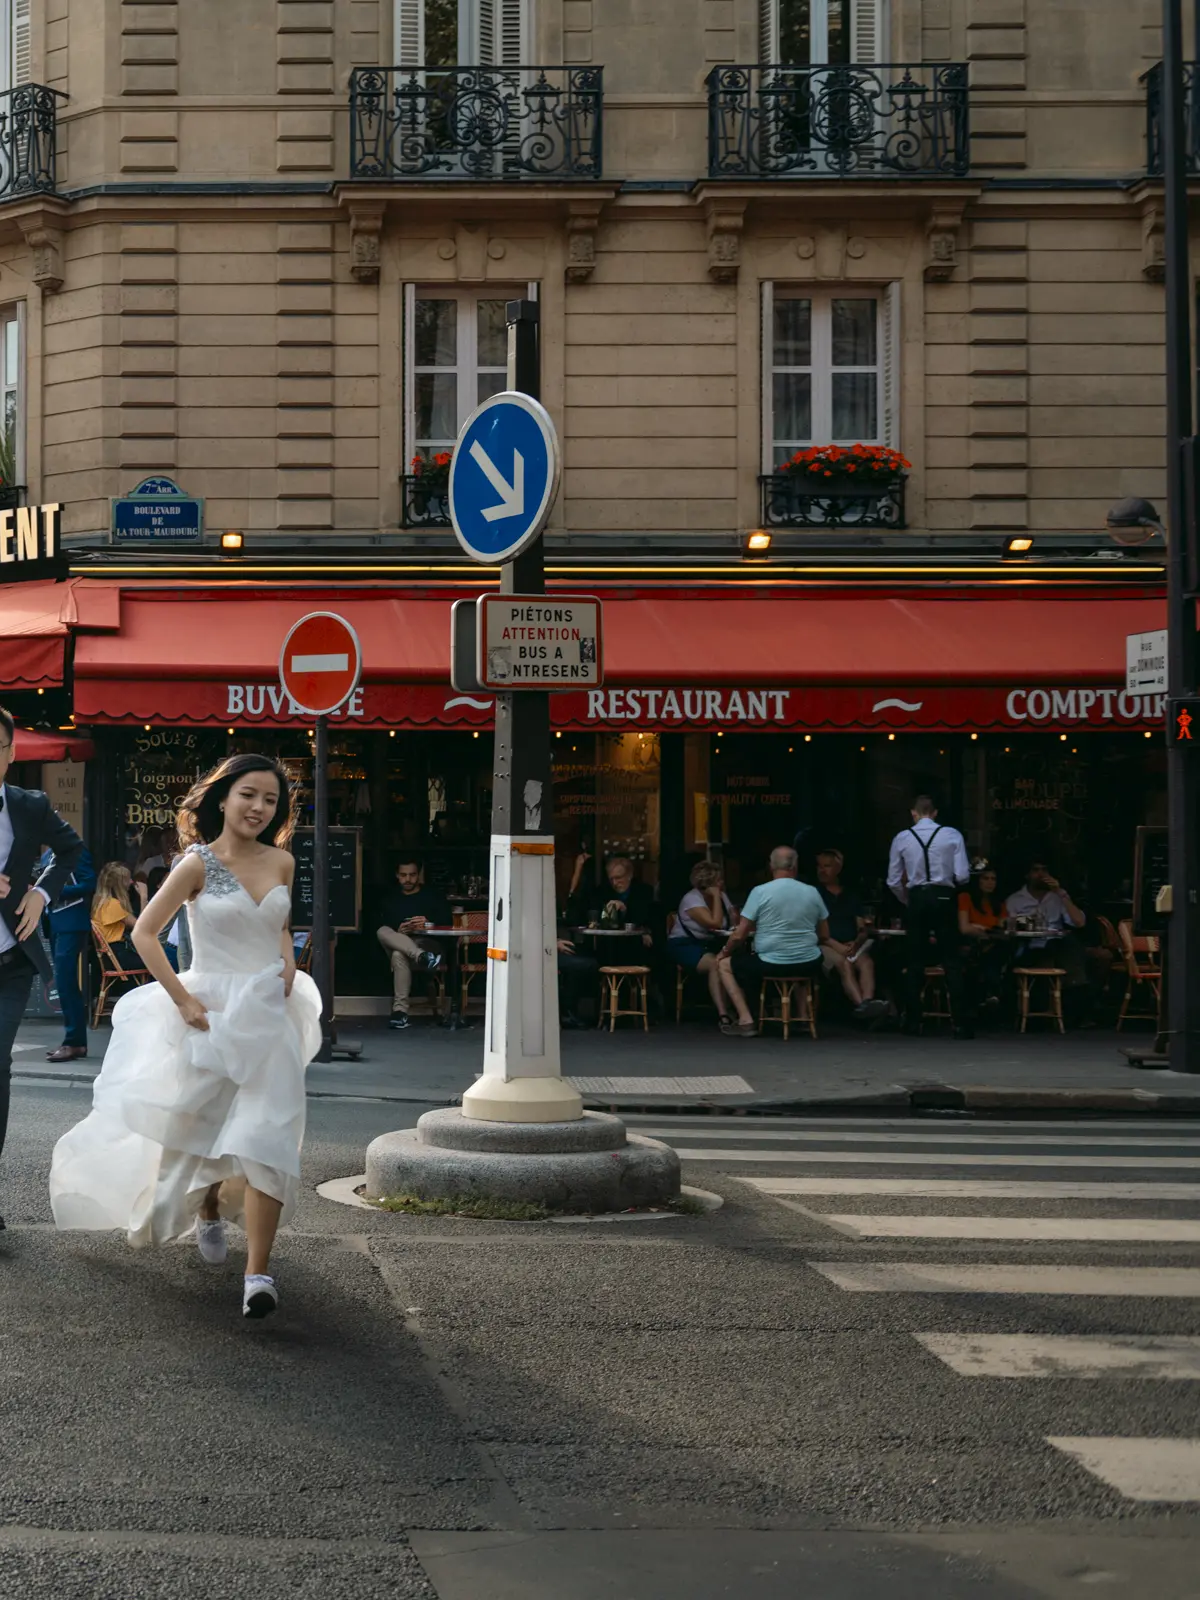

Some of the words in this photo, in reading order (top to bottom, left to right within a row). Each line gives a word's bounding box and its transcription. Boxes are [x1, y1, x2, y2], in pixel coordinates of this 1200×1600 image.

[134, 506, 180, 515] BOULEVARD
[151, 517, 164, 525] DE
[116, 528, 127, 537] LA
[129, 527, 199, 537] TOUR-MAUBOURG
[511, 606, 573, 622] PIÉTONS
[502, 627, 580, 640] ATTENTION
[519, 646, 547, 659] BUS
[555, 647, 563, 659] A
[513, 664, 589, 677] NTRESENS
[227, 685, 365, 715] BUVE
[587, 689, 790, 719] RESTAURANT
[1005, 799, 1060, 810] LIMONADE
